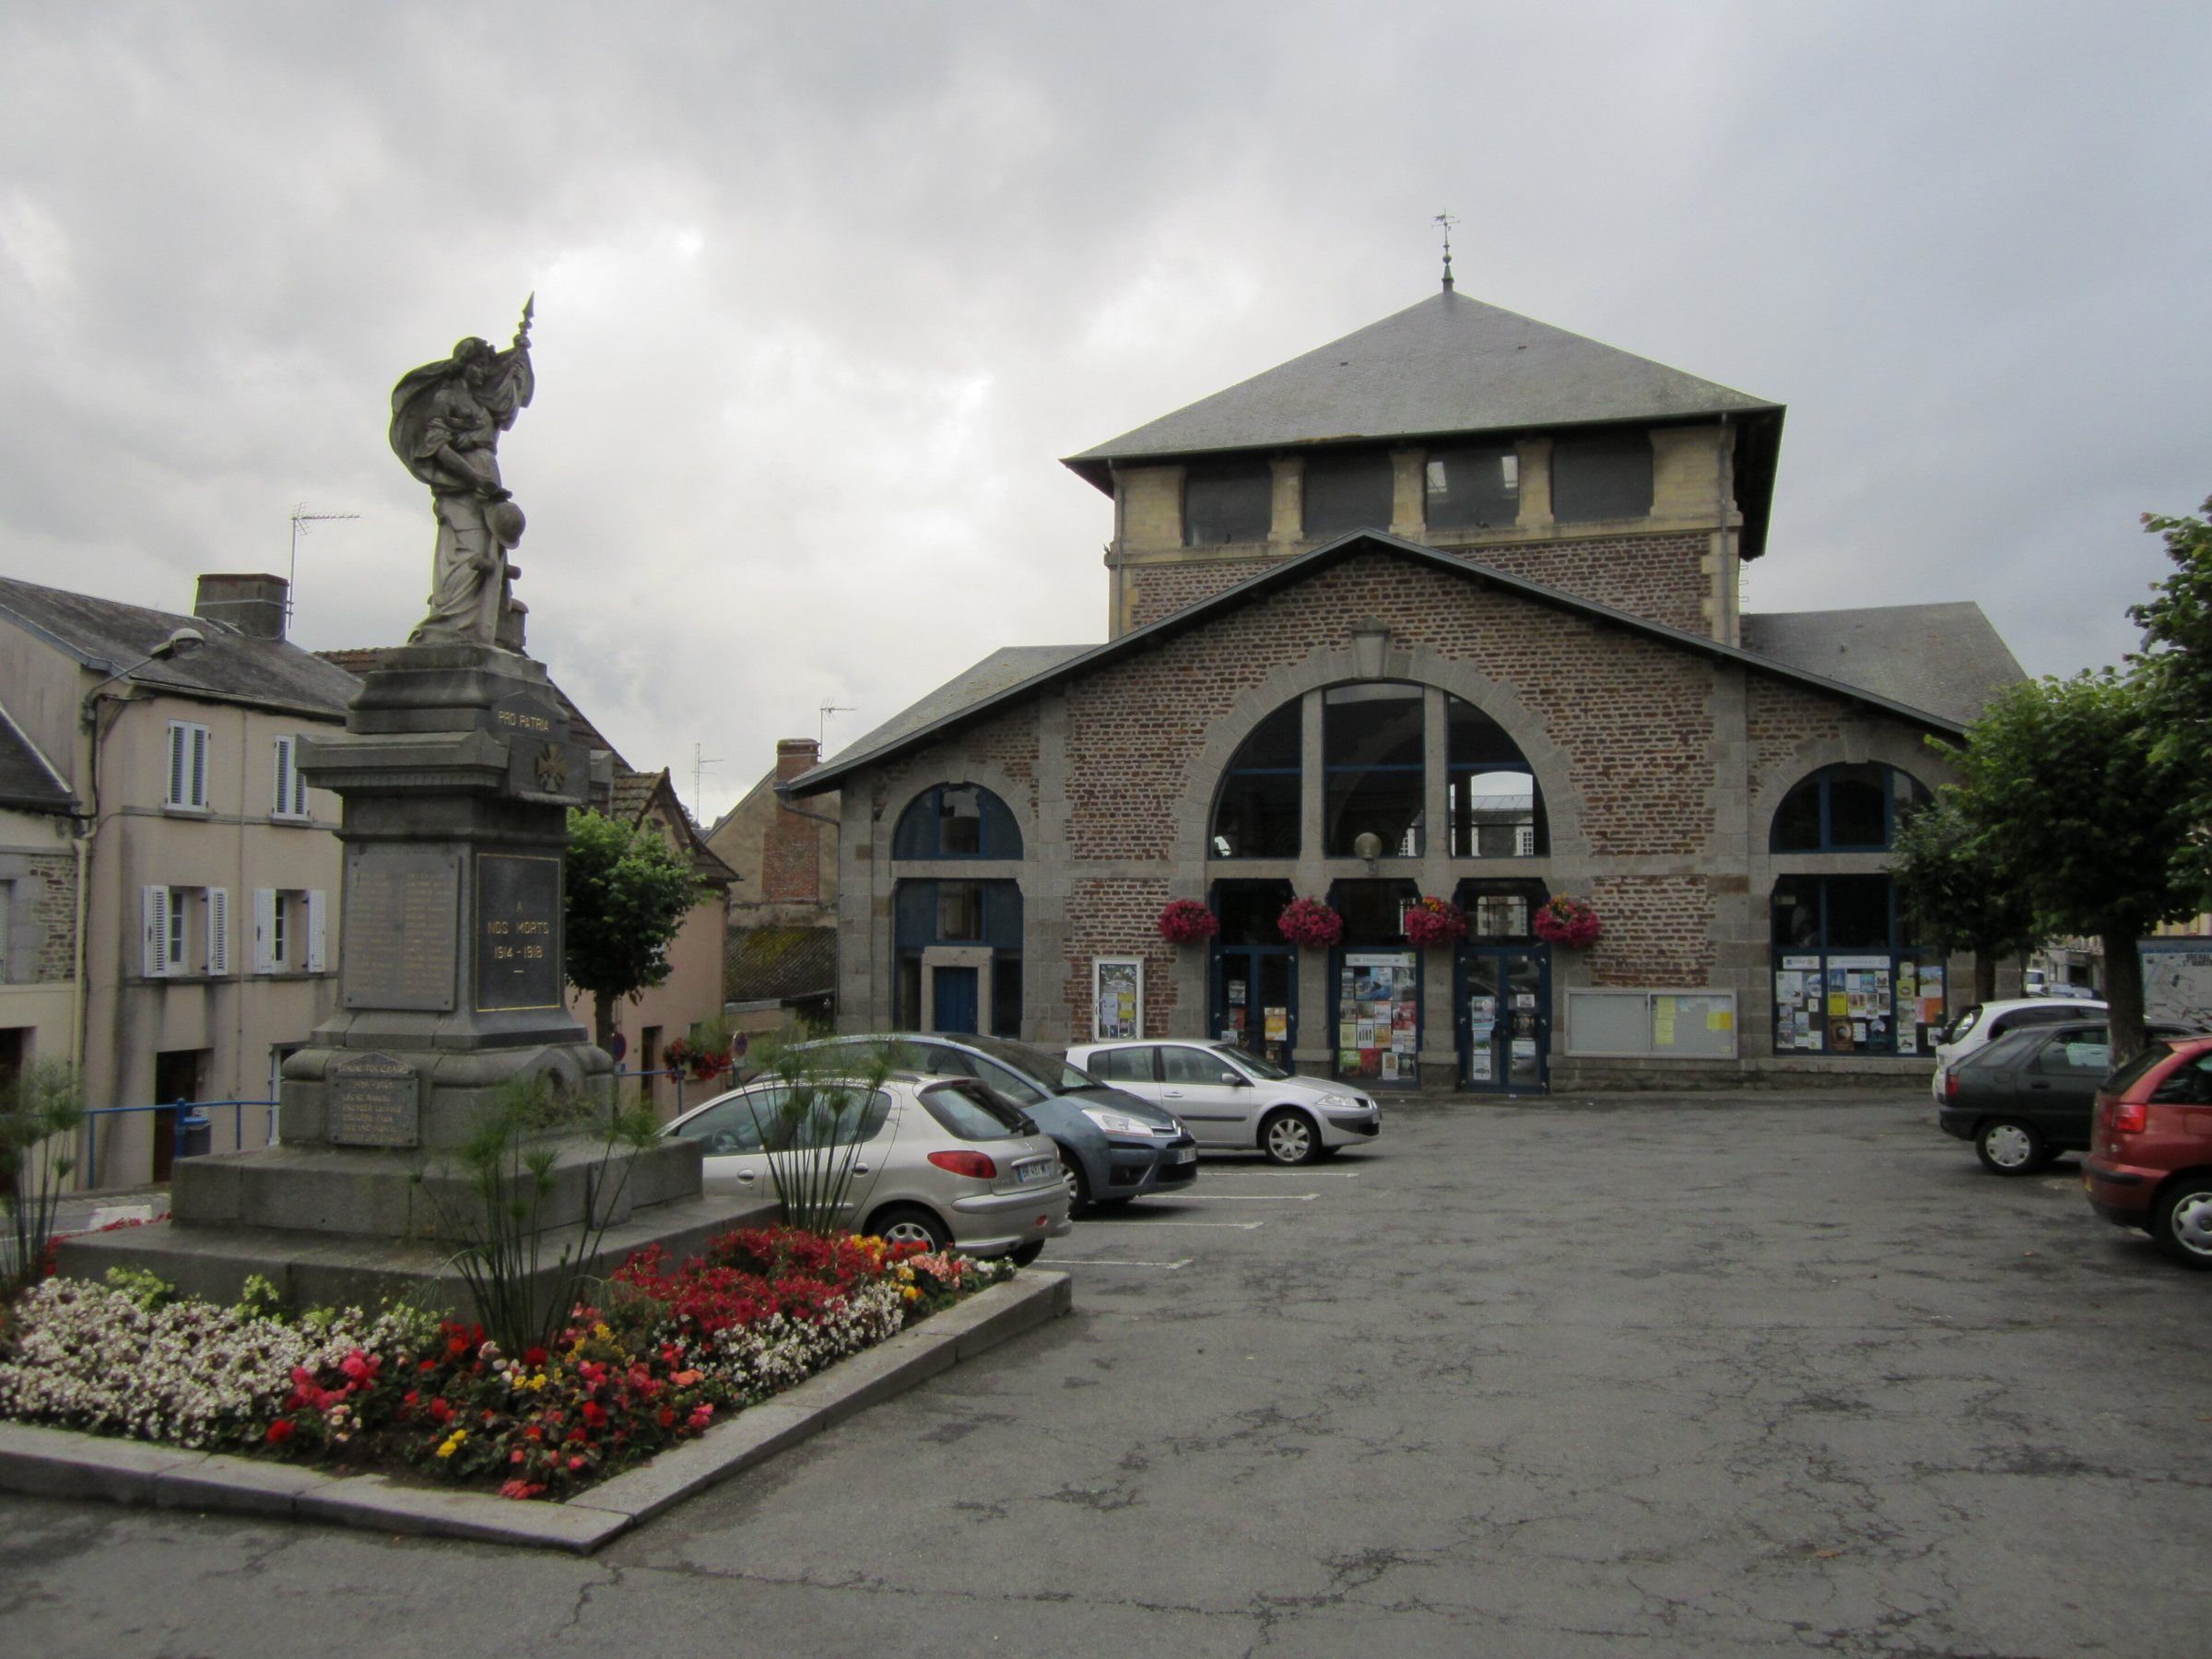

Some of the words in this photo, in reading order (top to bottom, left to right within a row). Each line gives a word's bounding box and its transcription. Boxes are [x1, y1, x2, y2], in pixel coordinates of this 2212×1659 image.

[498, 711, 516, 726] PRO
[519, 714, 549, 732] PATRIA
[516, 900, 524, 912] A
[488, 921, 509, 935] NOS
[515, 921, 549, 935] MORTS
[495, 946, 513, 959] 1914
[524, 946, 543, 959] 1918
